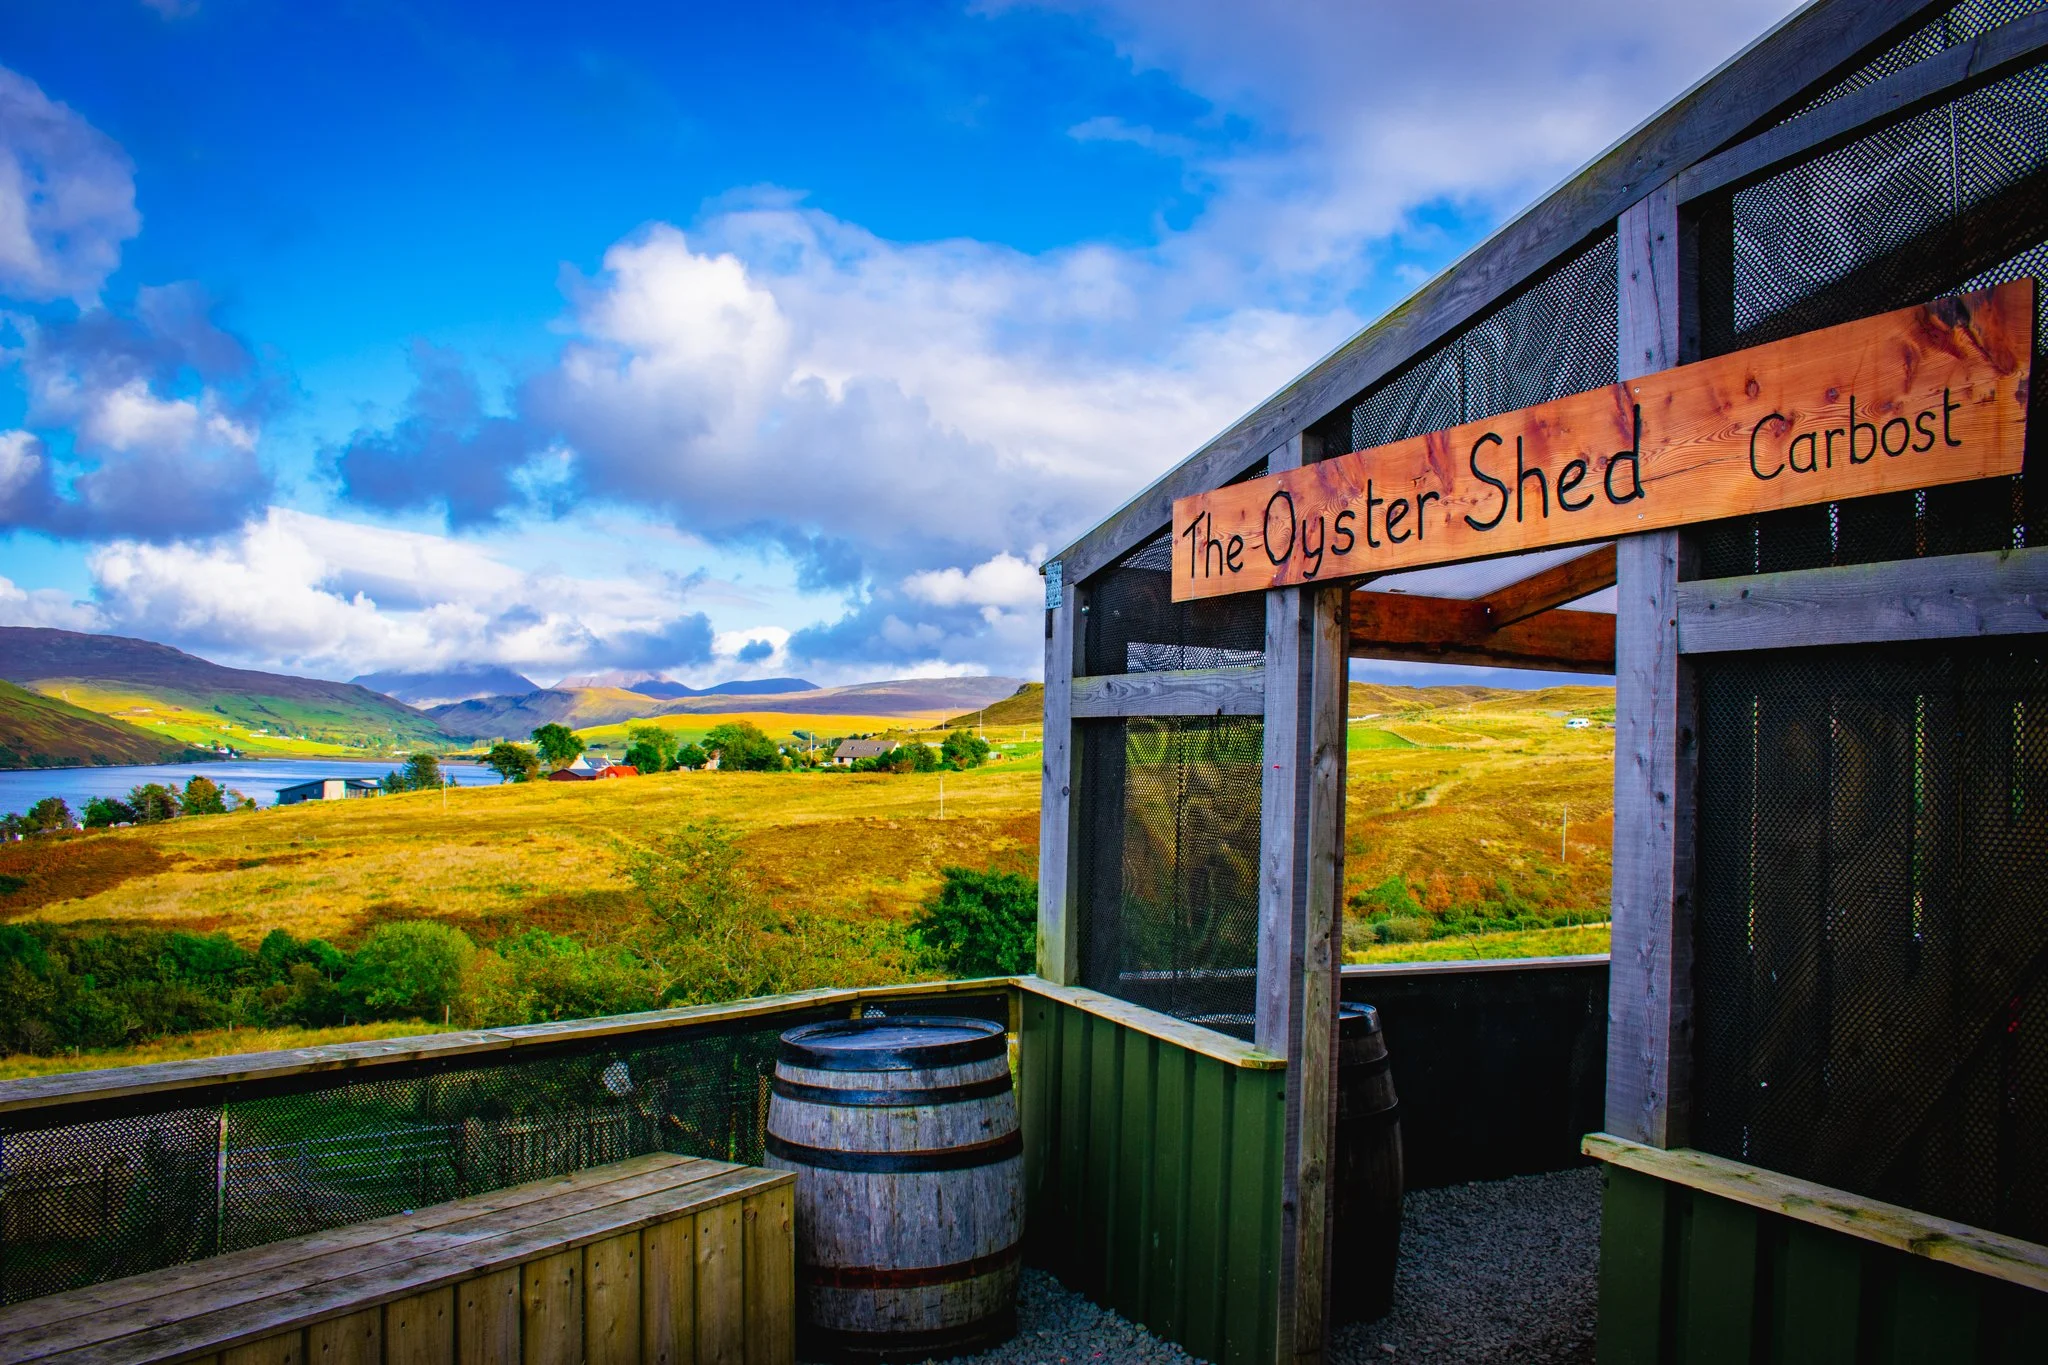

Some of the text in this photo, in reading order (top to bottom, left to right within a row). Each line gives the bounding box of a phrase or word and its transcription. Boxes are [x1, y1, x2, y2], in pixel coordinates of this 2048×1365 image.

[1182, 387, 1961, 579] The Oyster Shed Carbost
